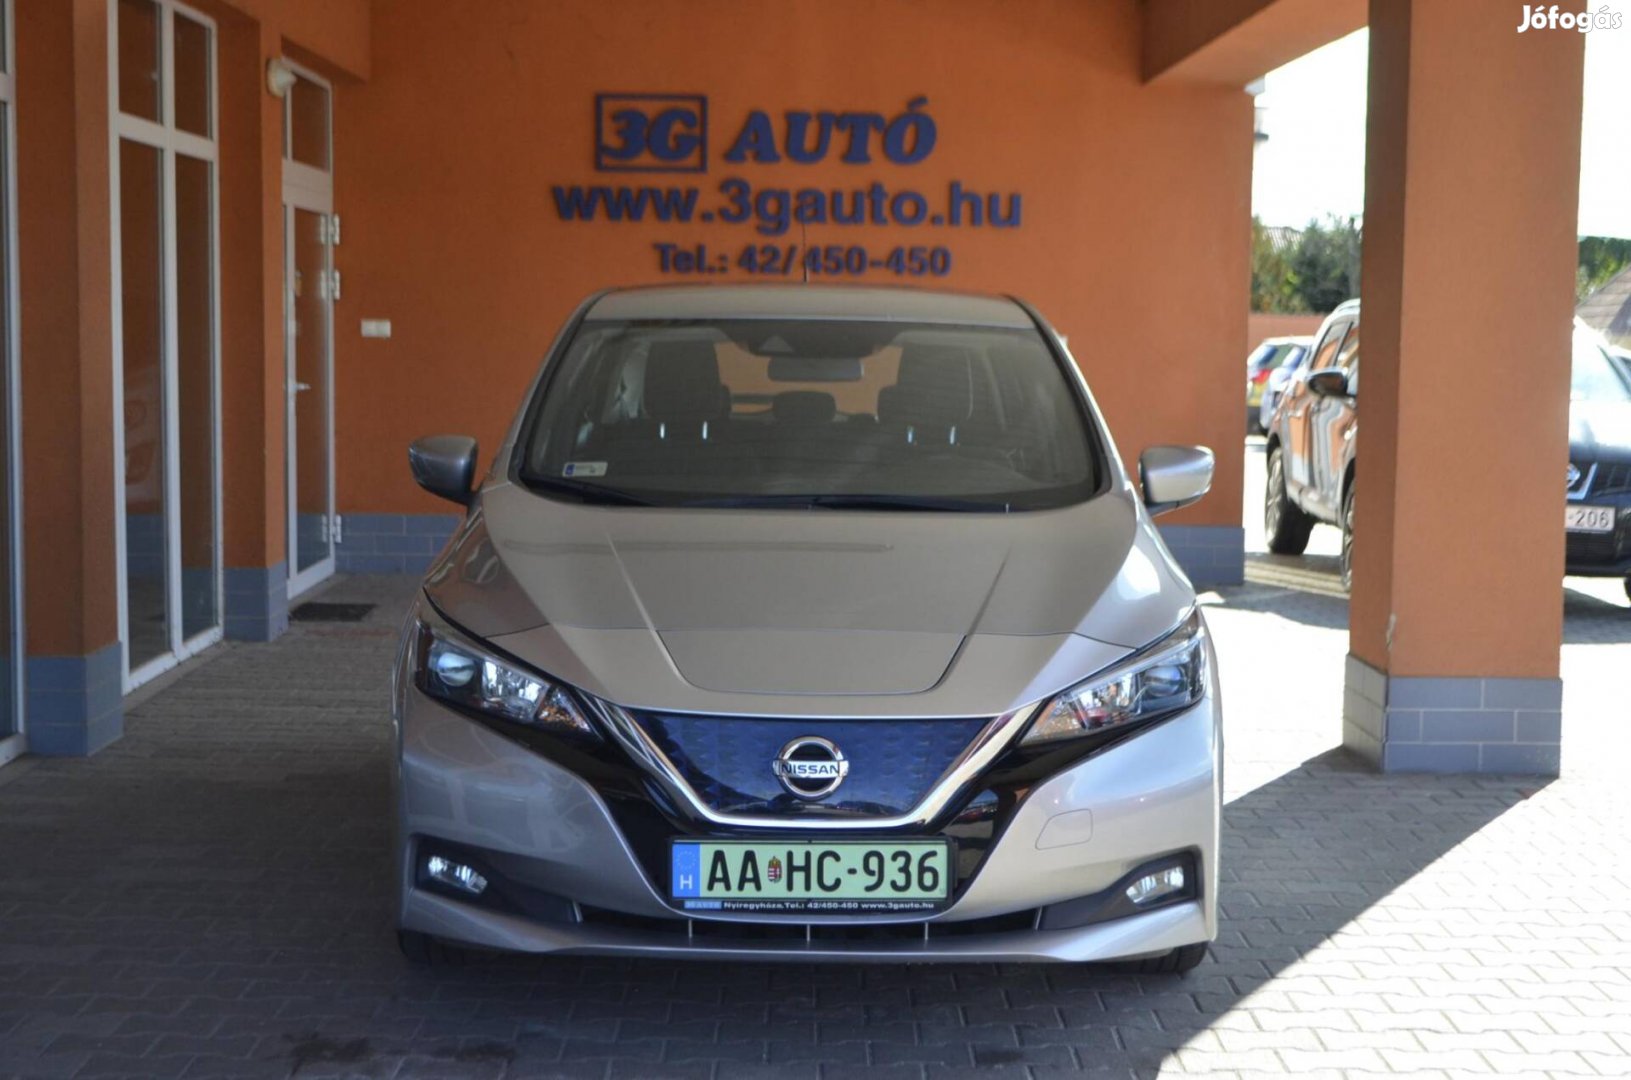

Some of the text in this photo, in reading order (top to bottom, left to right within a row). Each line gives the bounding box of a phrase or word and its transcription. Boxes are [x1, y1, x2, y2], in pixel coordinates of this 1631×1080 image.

[601, 97, 937, 165] 3G AUTÓ
[551, 178, 1022, 236] www.3gauto.hu
[653, 243, 730, 274] Tel.:
[781, 764, 840, 775] NISSAN
[679, 874, 693, 890] H
